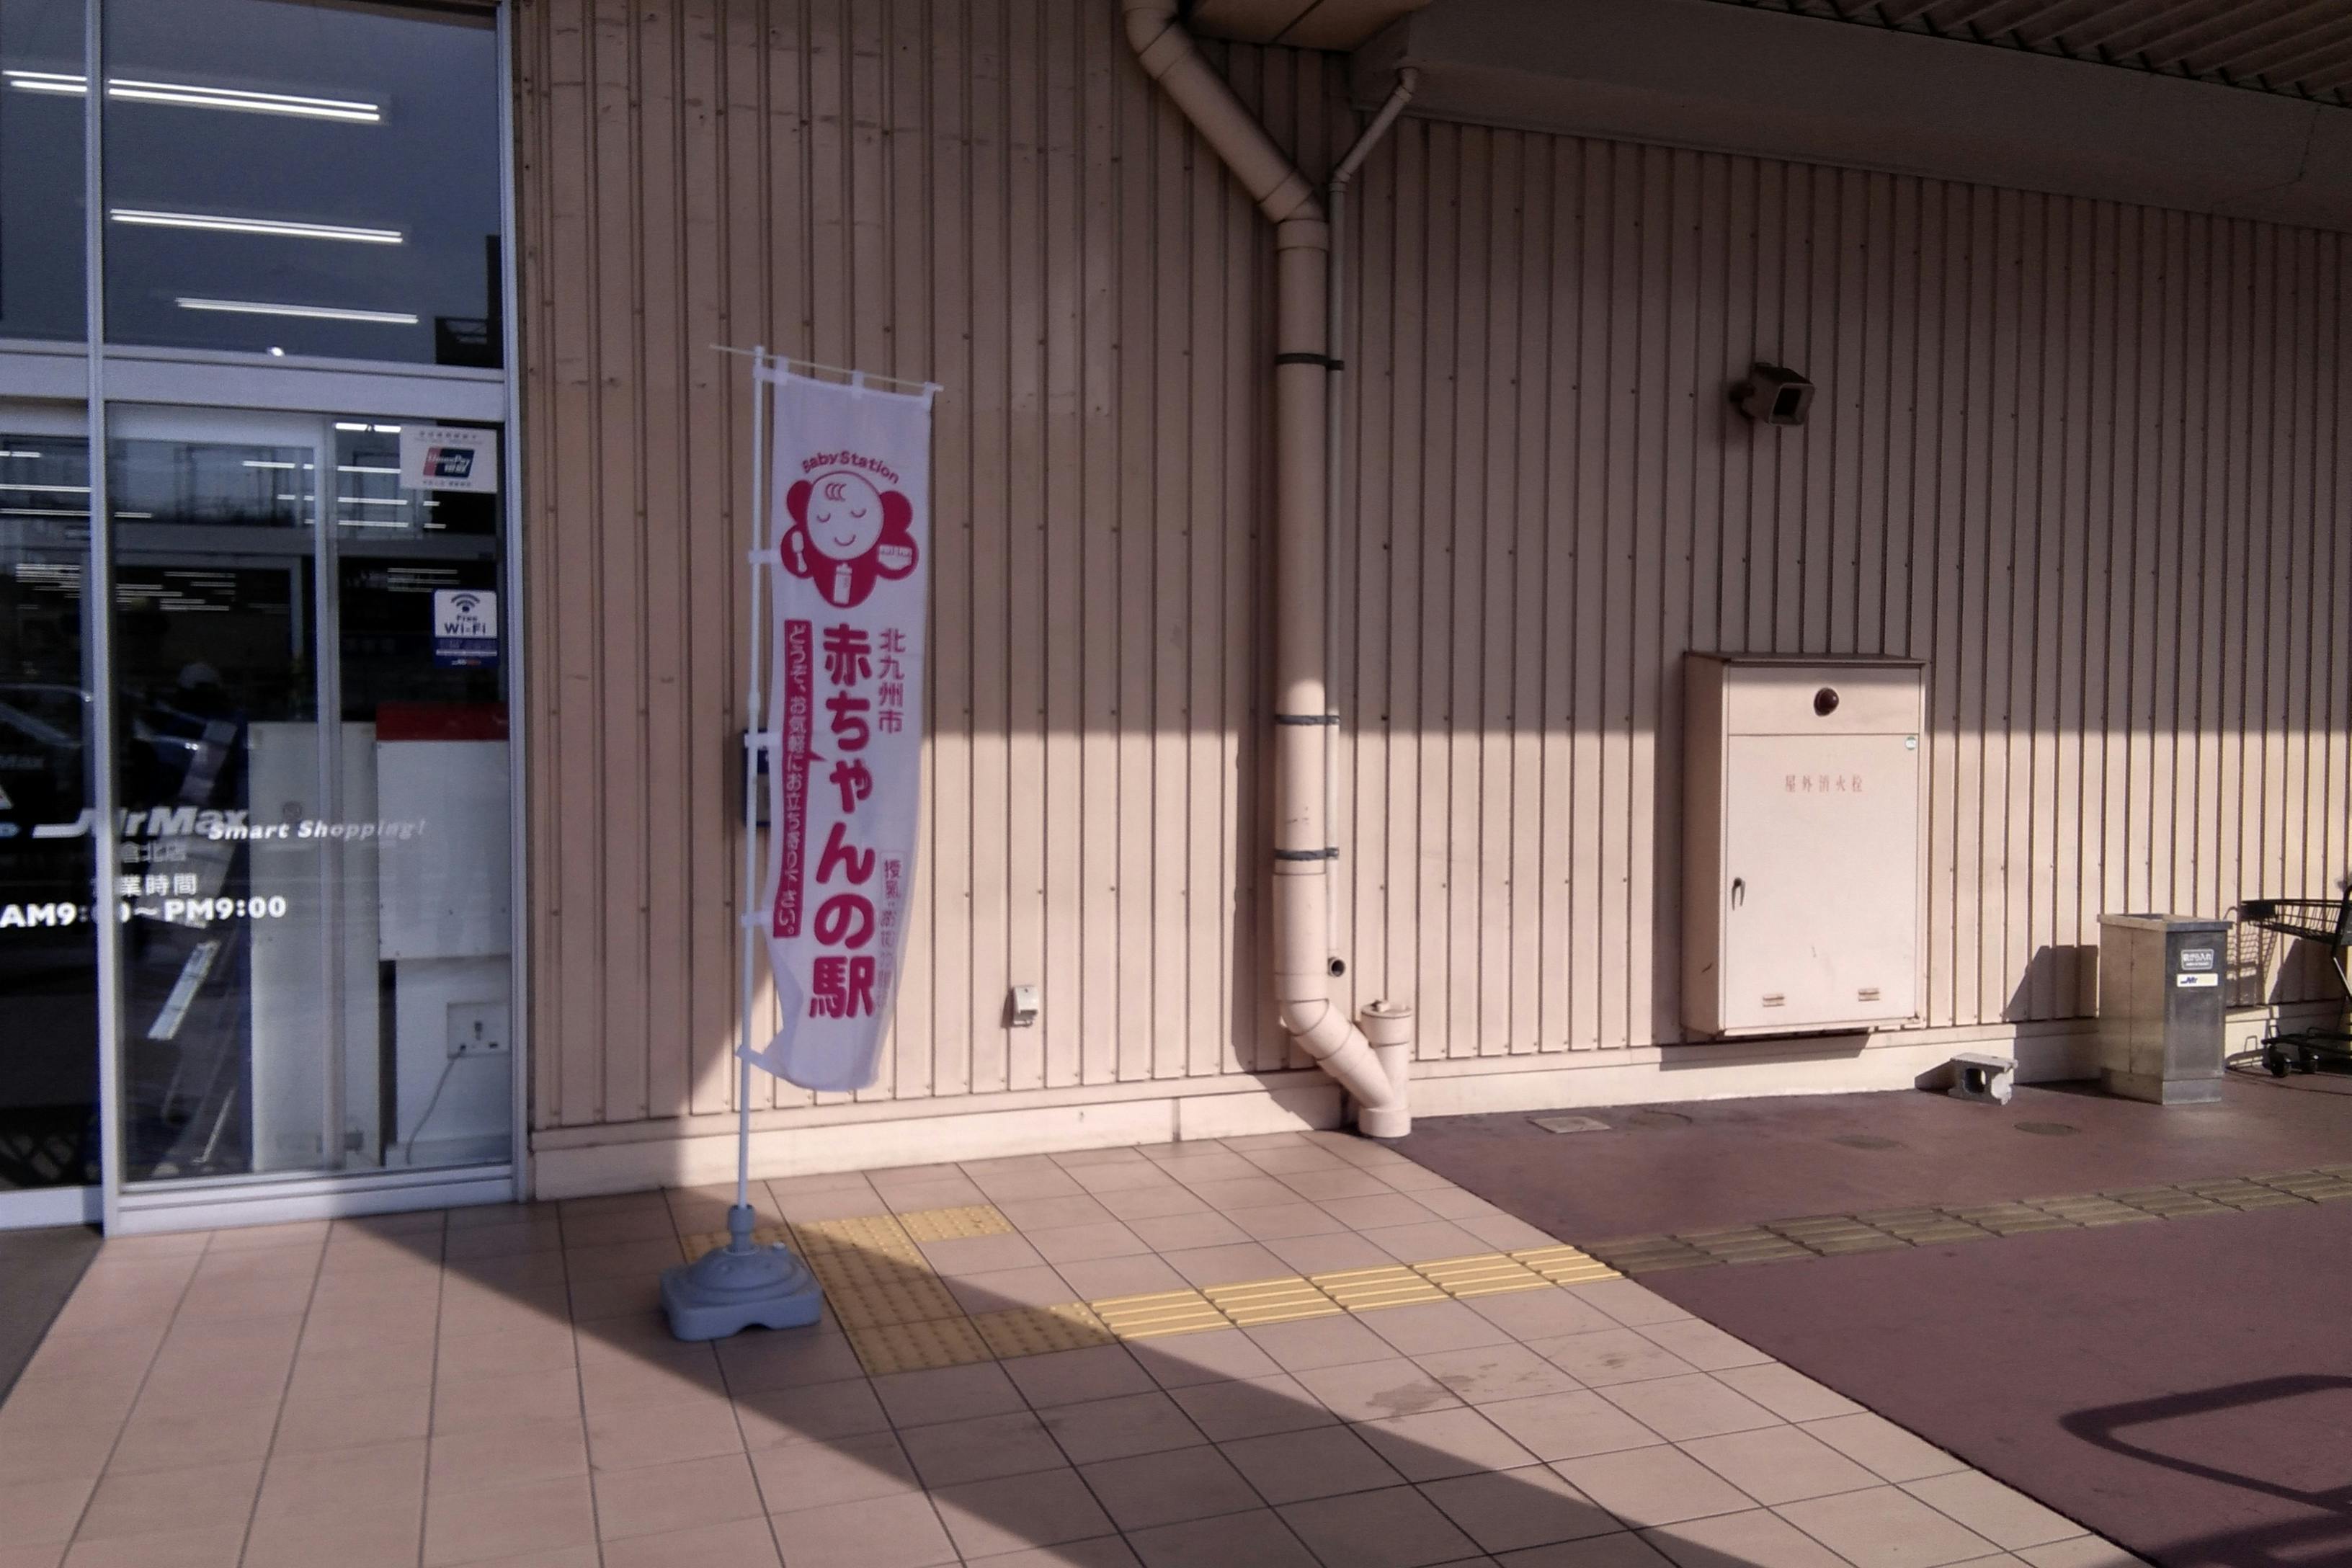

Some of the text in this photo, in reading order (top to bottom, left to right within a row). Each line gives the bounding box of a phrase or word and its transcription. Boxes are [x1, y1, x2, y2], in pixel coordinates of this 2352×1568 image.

[444, 623, 486, 635] Wi-Fi
[878, 628, 906, 734] 北九州市
[1786, 775, 1863, 792] 屋外消火栓
[208, 819, 426, 842] Smart Shopping!
[809, 623, 876, 1019] 赤ちゃんの駅
